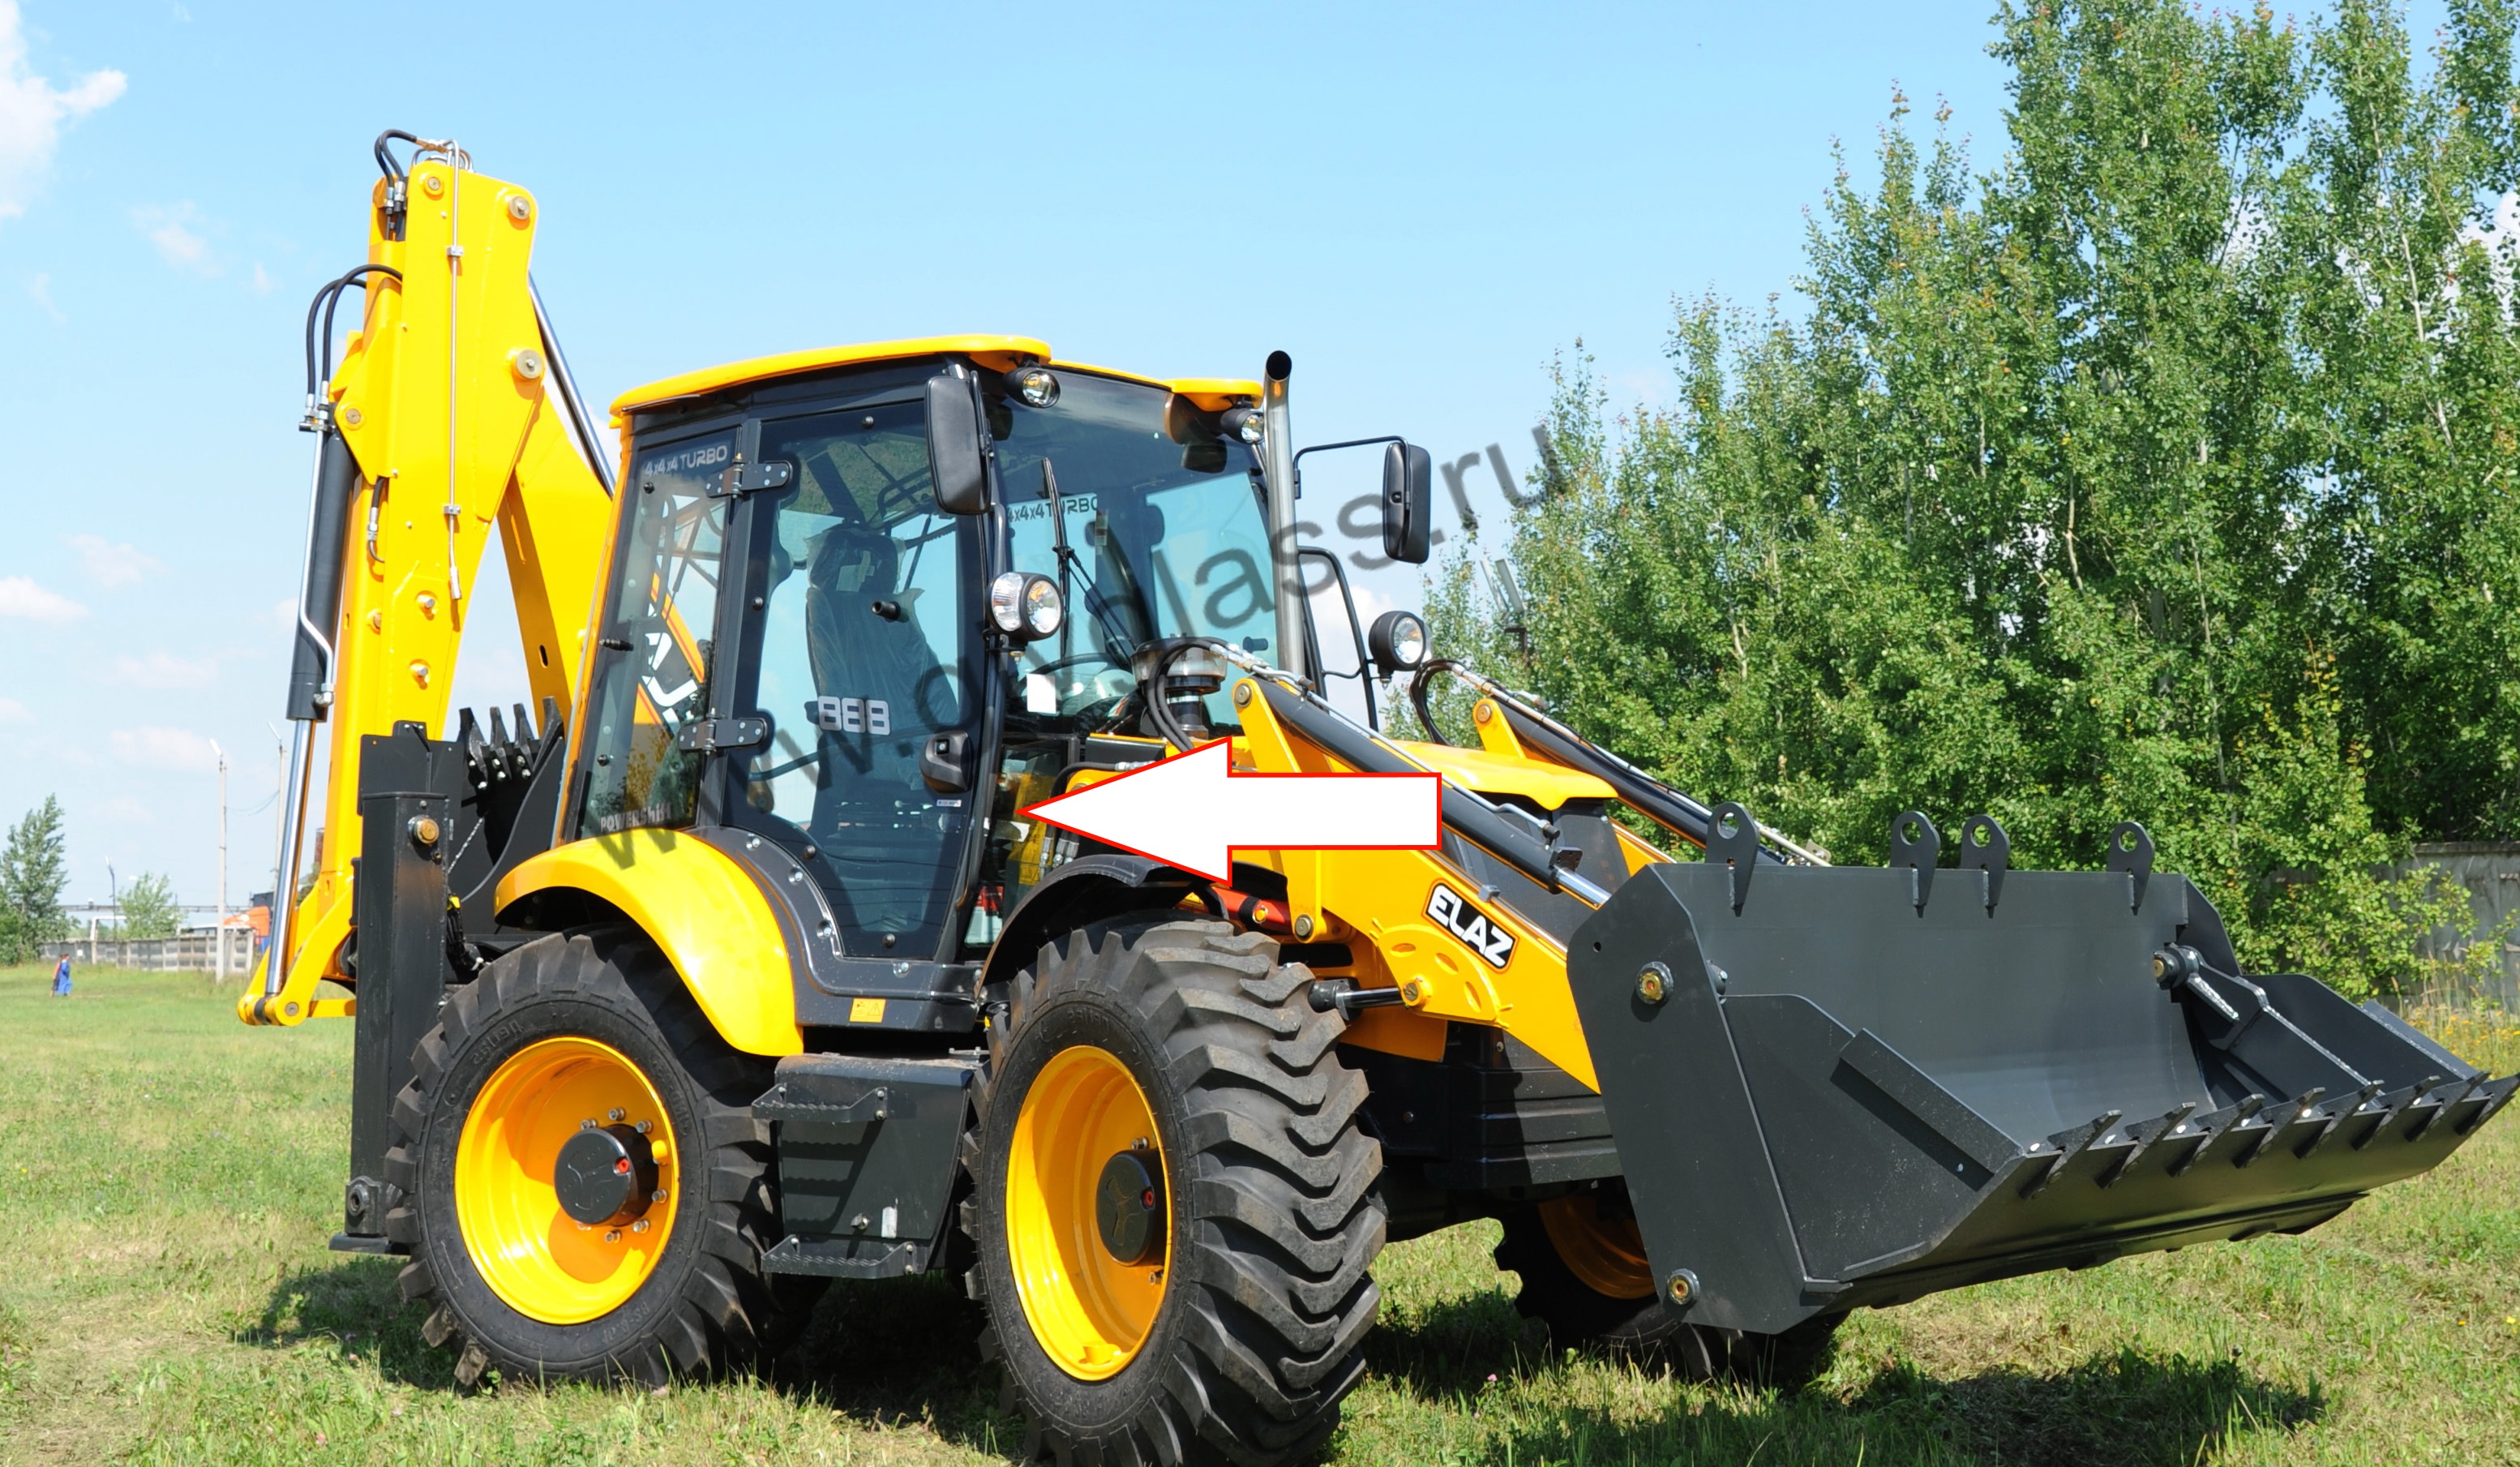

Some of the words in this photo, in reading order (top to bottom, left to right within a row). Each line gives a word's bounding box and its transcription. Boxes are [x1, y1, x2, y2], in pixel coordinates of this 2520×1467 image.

[679, 445, 727, 470] TURBO
[818, 696, 890, 735] 888
[1427, 884, 1514, 967] ELAZ
